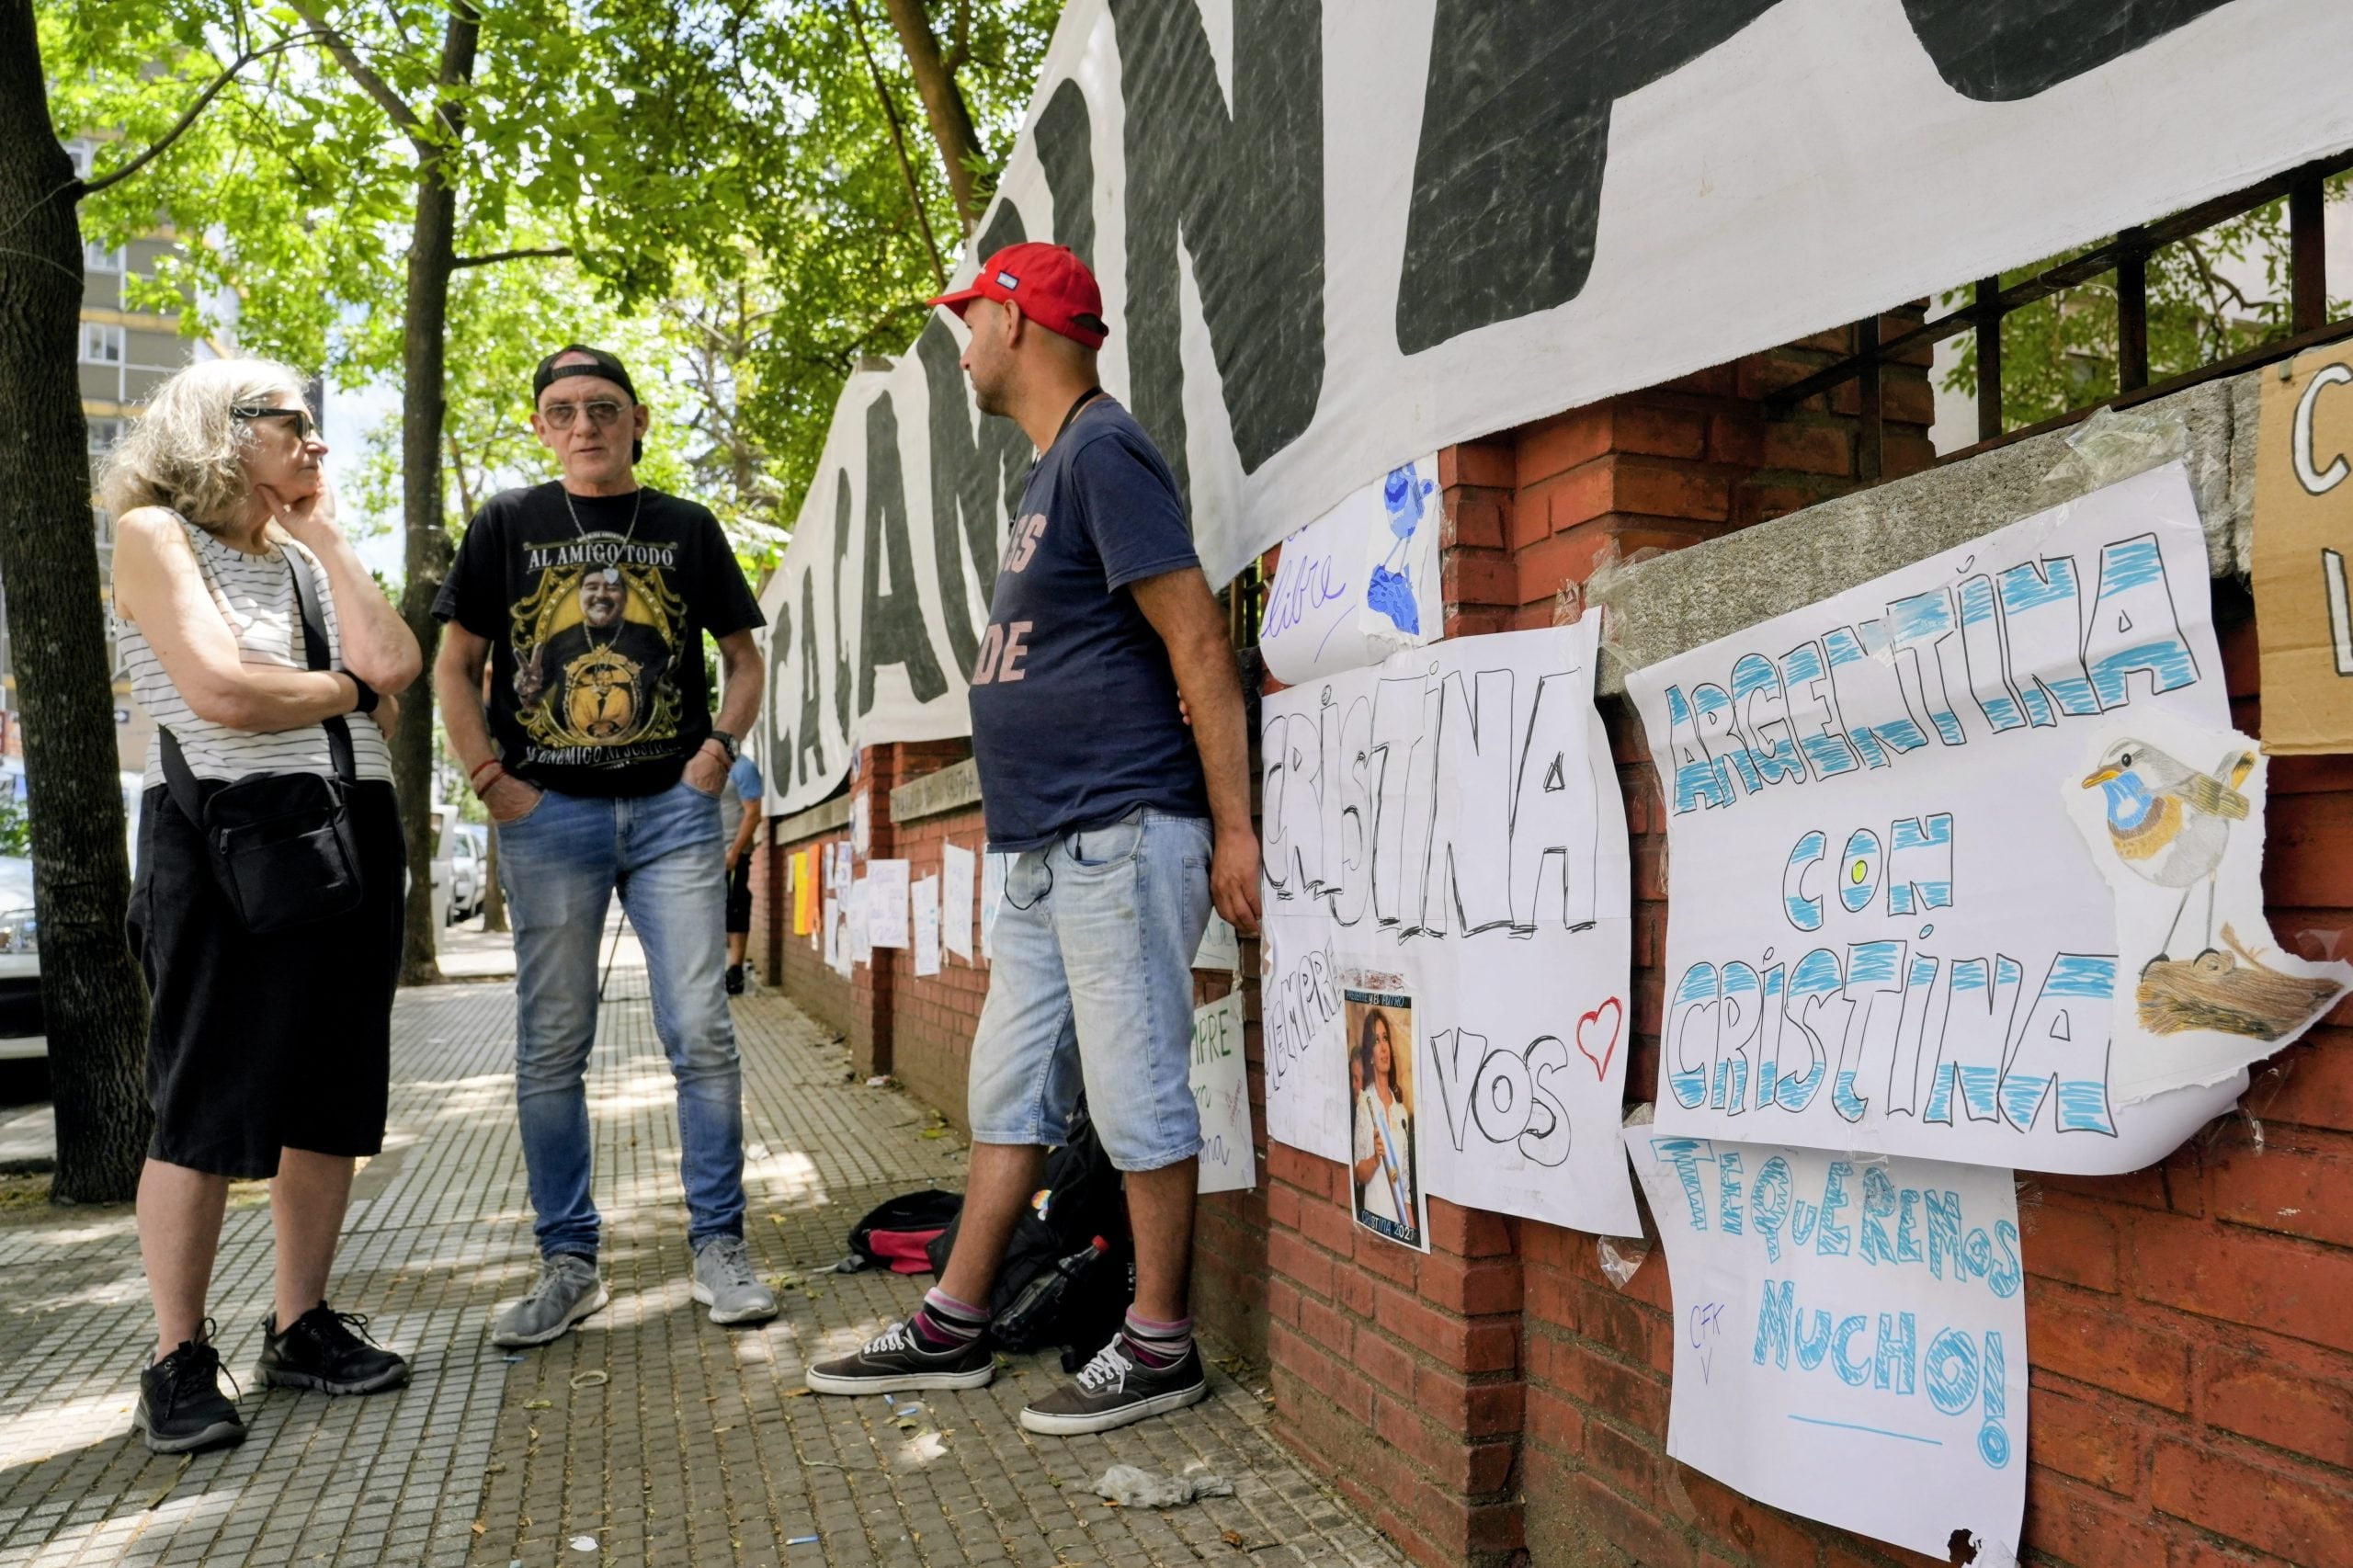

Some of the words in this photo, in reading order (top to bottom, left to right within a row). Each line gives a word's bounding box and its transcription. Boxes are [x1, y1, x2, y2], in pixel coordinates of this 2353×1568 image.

[529, 548, 552, 569] AL
[556, 544, 620, 565] AMIGO
[623, 547, 673, 566] TODO
[1260, 554, 1347, 639] libre
[972, 620, 1033, 685] DE
[1665, 531, 2202, 816] ARGENTINA
[1261, 660, 1597, 945] CRISTINA
[1782, 812, 1954, 932] CON
[1665, 923, 2119, 1138] CRISTINA
[1430, 1027, 1571, 1167] VOS
[1361, 1210, 1392, 1236] CRISTINA
[1750, 1155, 2022, 1299] QUEREMOS
[1690, 1302, 1724, 1349] CFK
[1753, 1278, 2010, 1470] MUCHO!
